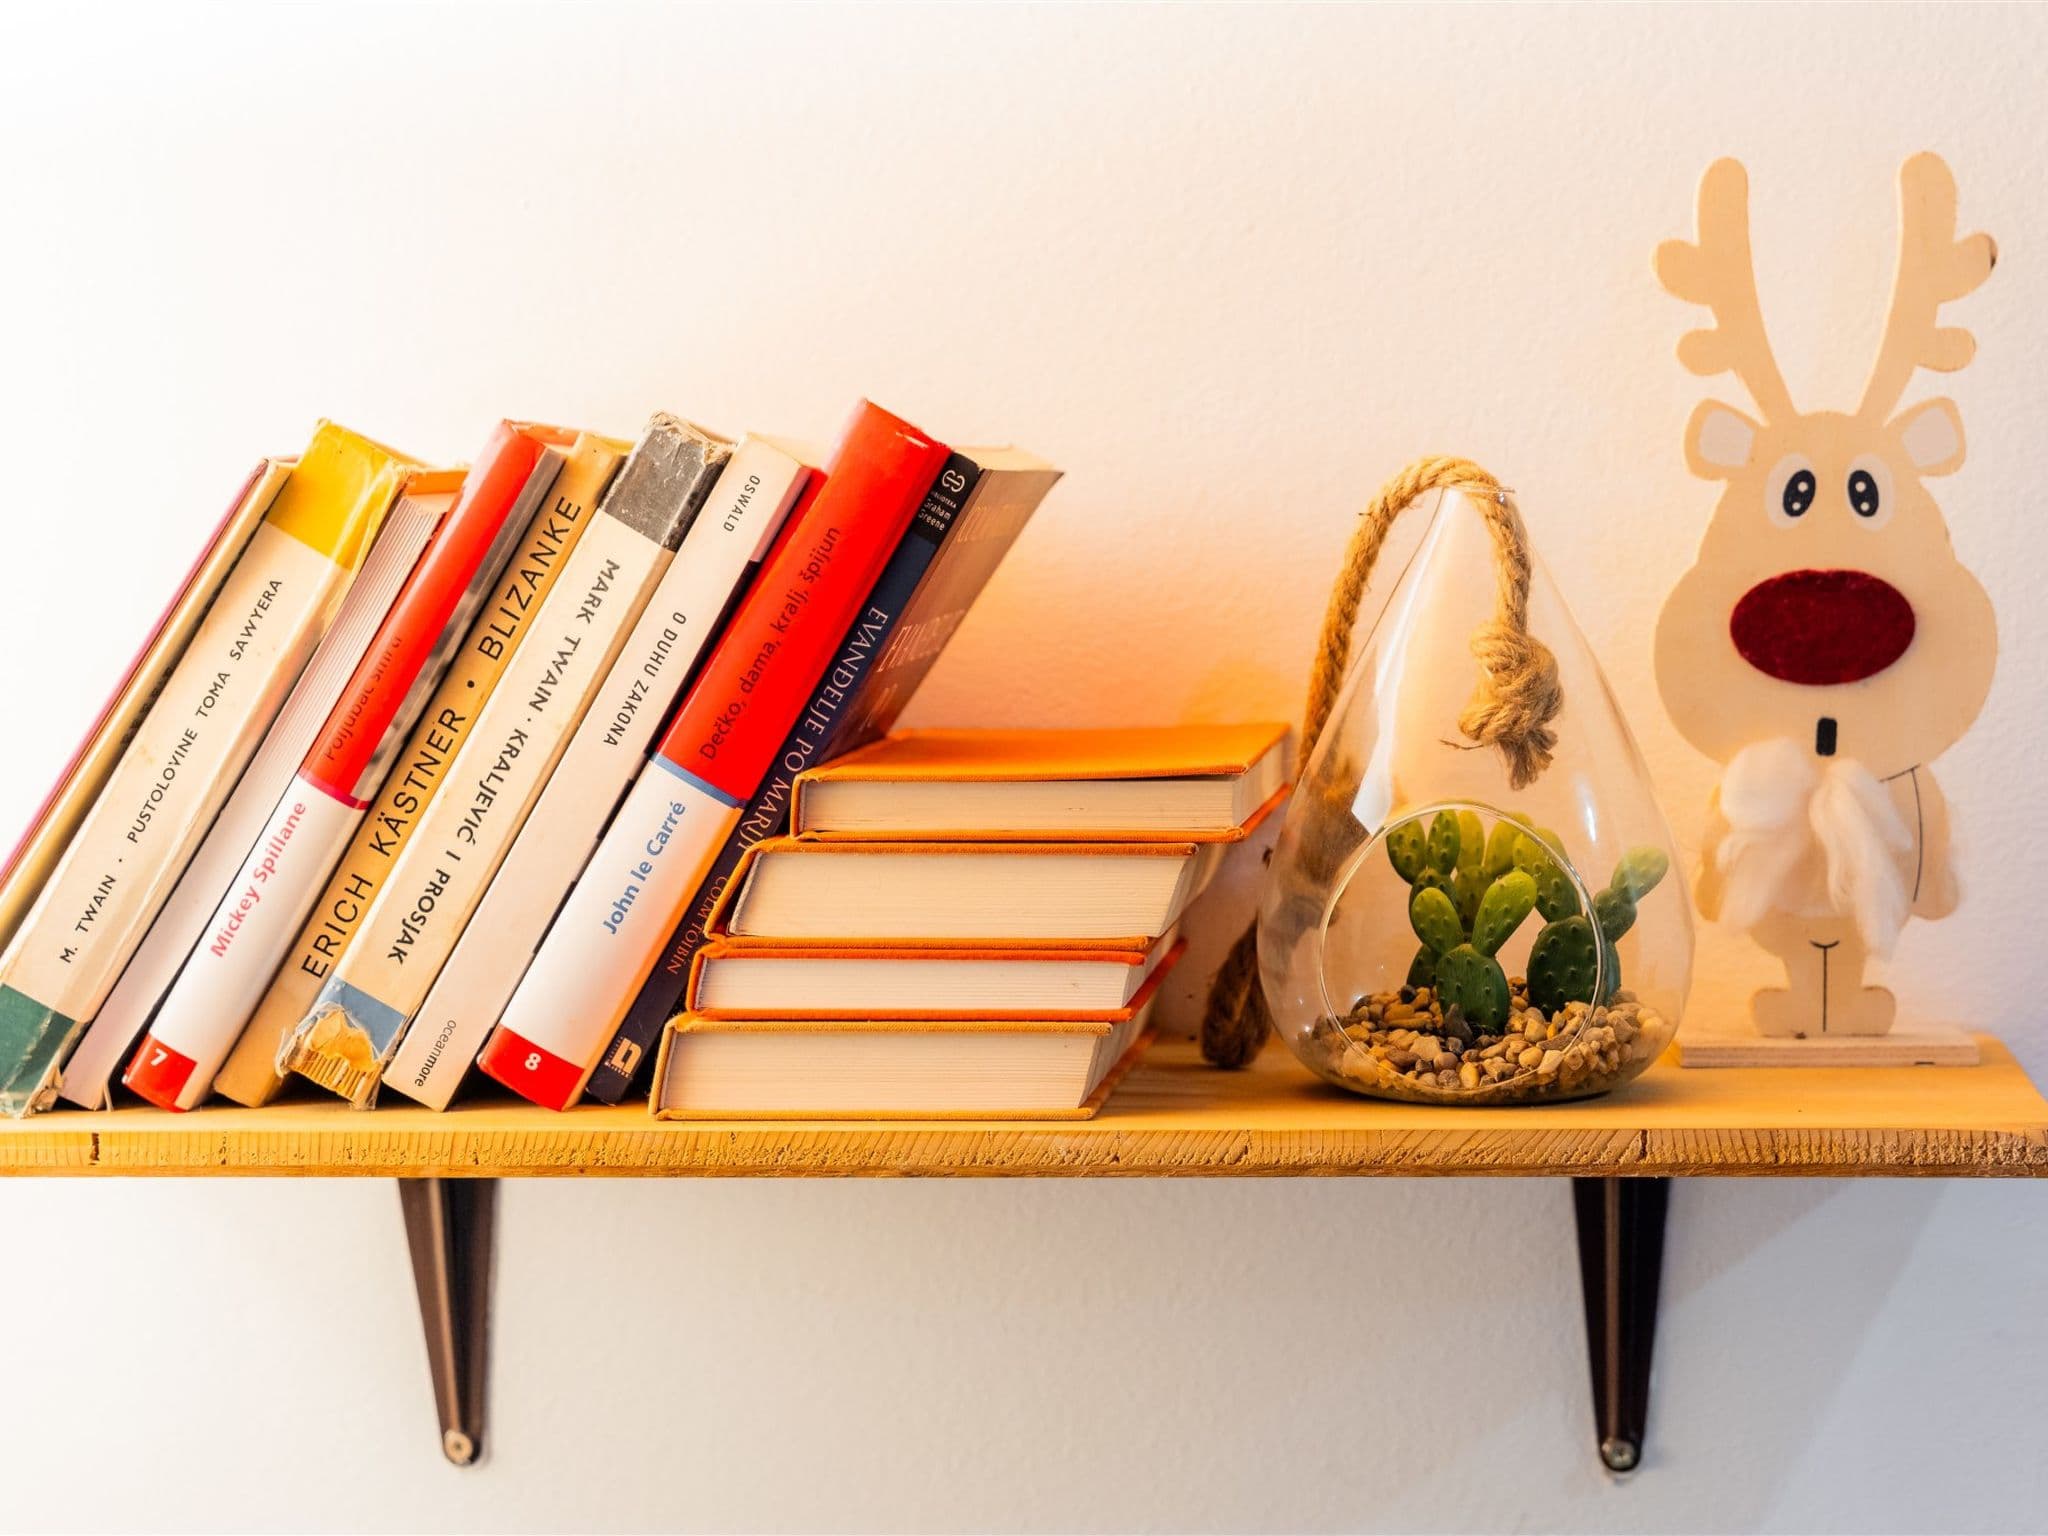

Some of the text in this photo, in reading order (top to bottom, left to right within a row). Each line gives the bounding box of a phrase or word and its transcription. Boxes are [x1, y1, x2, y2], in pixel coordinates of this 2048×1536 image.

[723, 475, 761, 532] OSWALD
[918, 508, 946, 531] Greene
[924, 498, 952, 521] Graham
[603, 611, 687, 746] O DUHU ZAKONA
[702, 527, 841, 761] Dečko, dama, kralj, špijun
[804, 606, 889, 735] EVANĐELJE
[59, 947, 78, 964] M.
[75, 874, 117, 932] TWAIN
[127, 727, 199, 843] PUSTOLOVINE
[195, 671, 231, 717] TOMA
[229, 579, 283, 661] SAWYERA
[301, 496, 582, 979] ERICH KÄSTNER BLIZANKE
[387, 558, 621, 965] MARK TWAIN KRALJEVIĆ I PROSJAK
[784, 737, 815, 772] PO
[210, 802, 306, 958] Mickey Spillane
[602, 800, 686, 935] John le Carré
[697, 875, 728, 917] COLM
[150, 1048, 168, 1067] 7
[414, 1019, 457, 1087] oceanmore
[524, 1052, 542, 1071] 8
